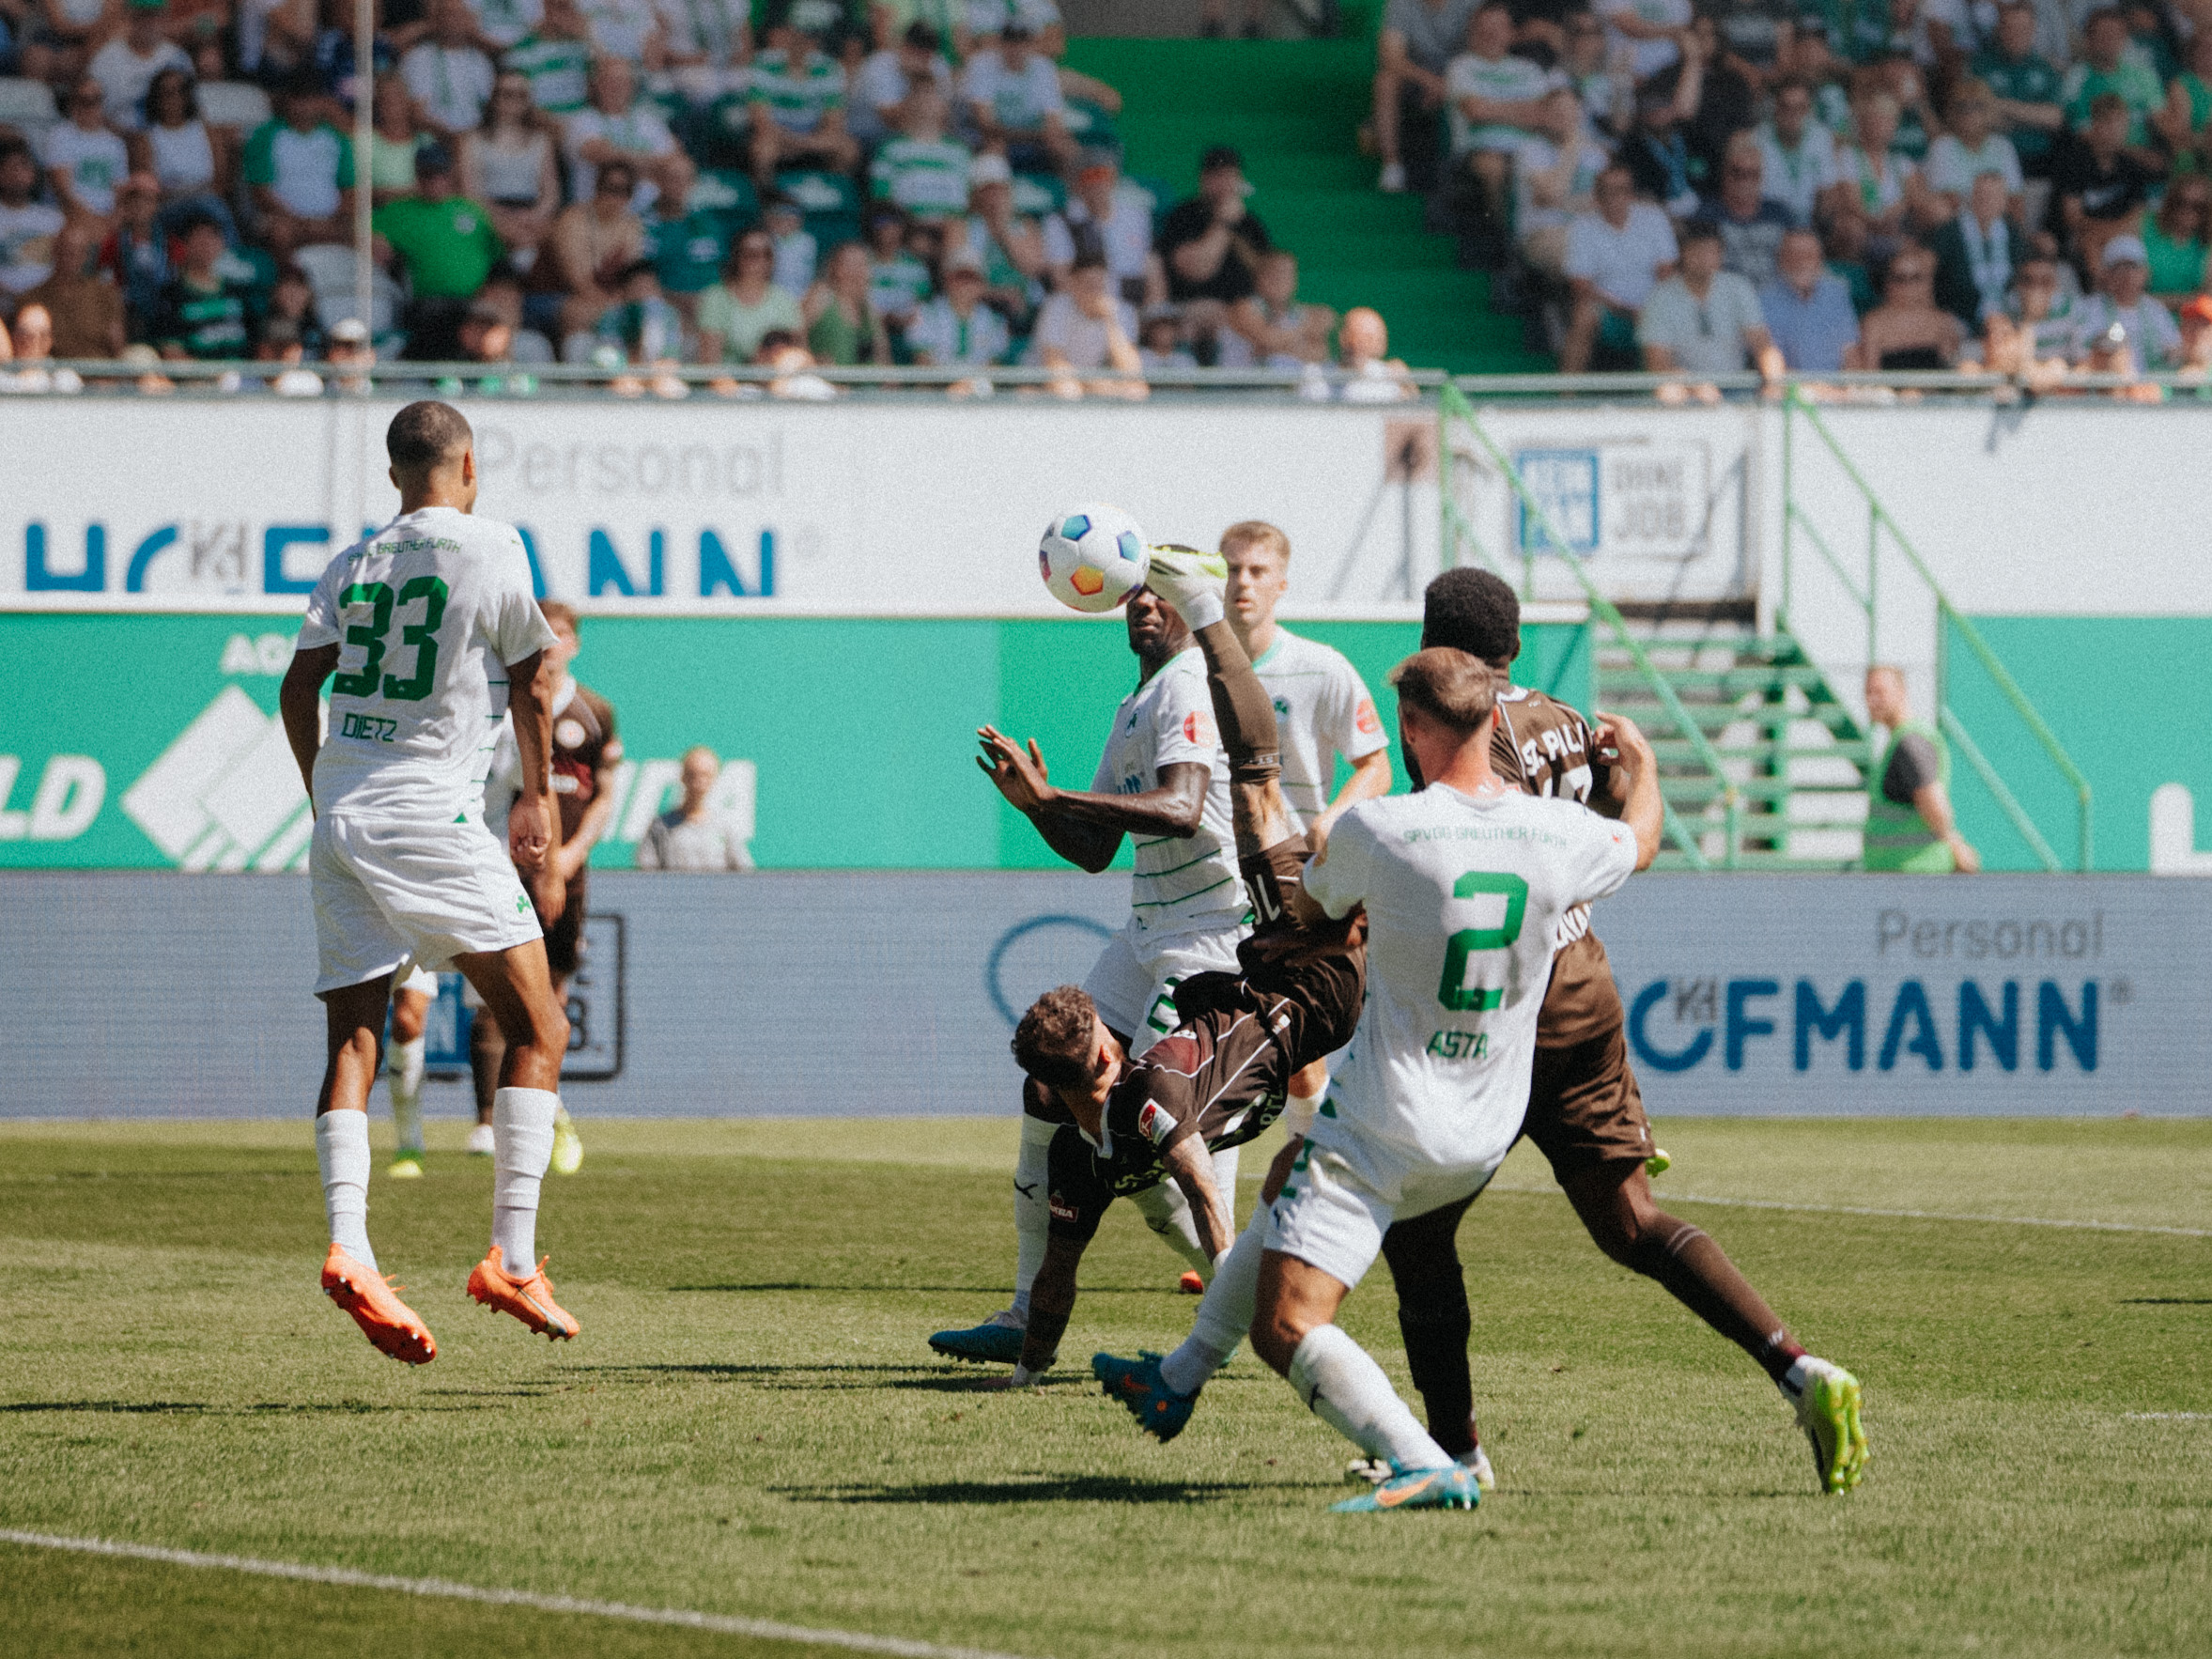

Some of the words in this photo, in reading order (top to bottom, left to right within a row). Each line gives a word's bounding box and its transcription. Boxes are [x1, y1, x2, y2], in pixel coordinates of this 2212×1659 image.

[475, 428, 785, 497] Personal
[333, 575, 450, 702] 33
[340, 712, 397, 742] DIETZ
[1438, 870, 1529, 1013] 2
[1879, 907, 2105, 959] Personal
[1426, 1031, 1489, 1060] ASTA
